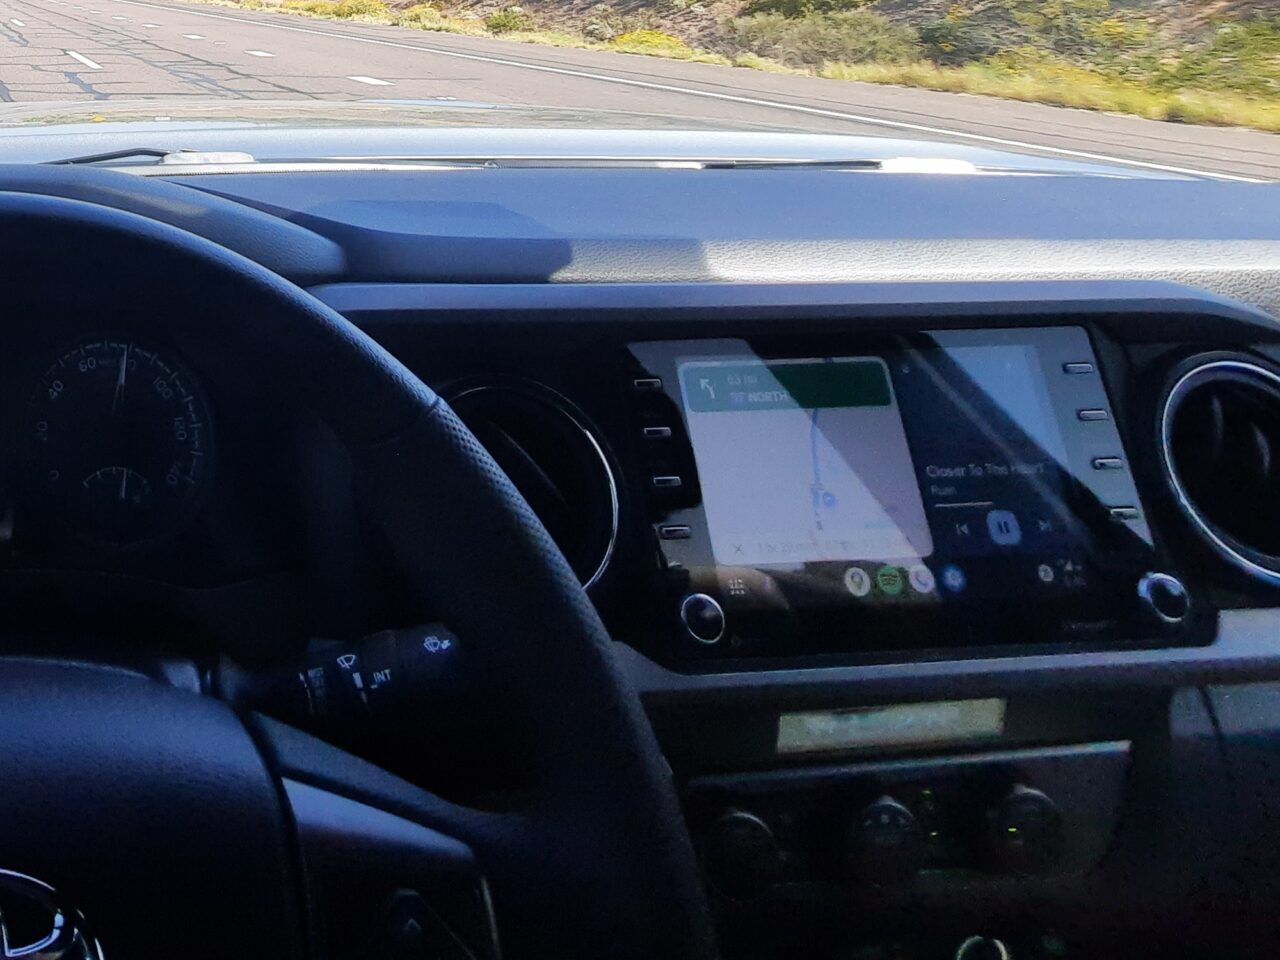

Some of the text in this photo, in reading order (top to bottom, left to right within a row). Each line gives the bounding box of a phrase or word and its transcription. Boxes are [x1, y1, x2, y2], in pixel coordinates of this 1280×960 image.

[78, 356, 98, 374] 60
[47, 379, 65, 401] 40
[152, 376, 175, 400] 100
[748, 390, 788, 403] NORTH
[926, 464, 966, 478] Closer
[968, 463, 983, 476] To
[373, 668, 392, 683] INT
